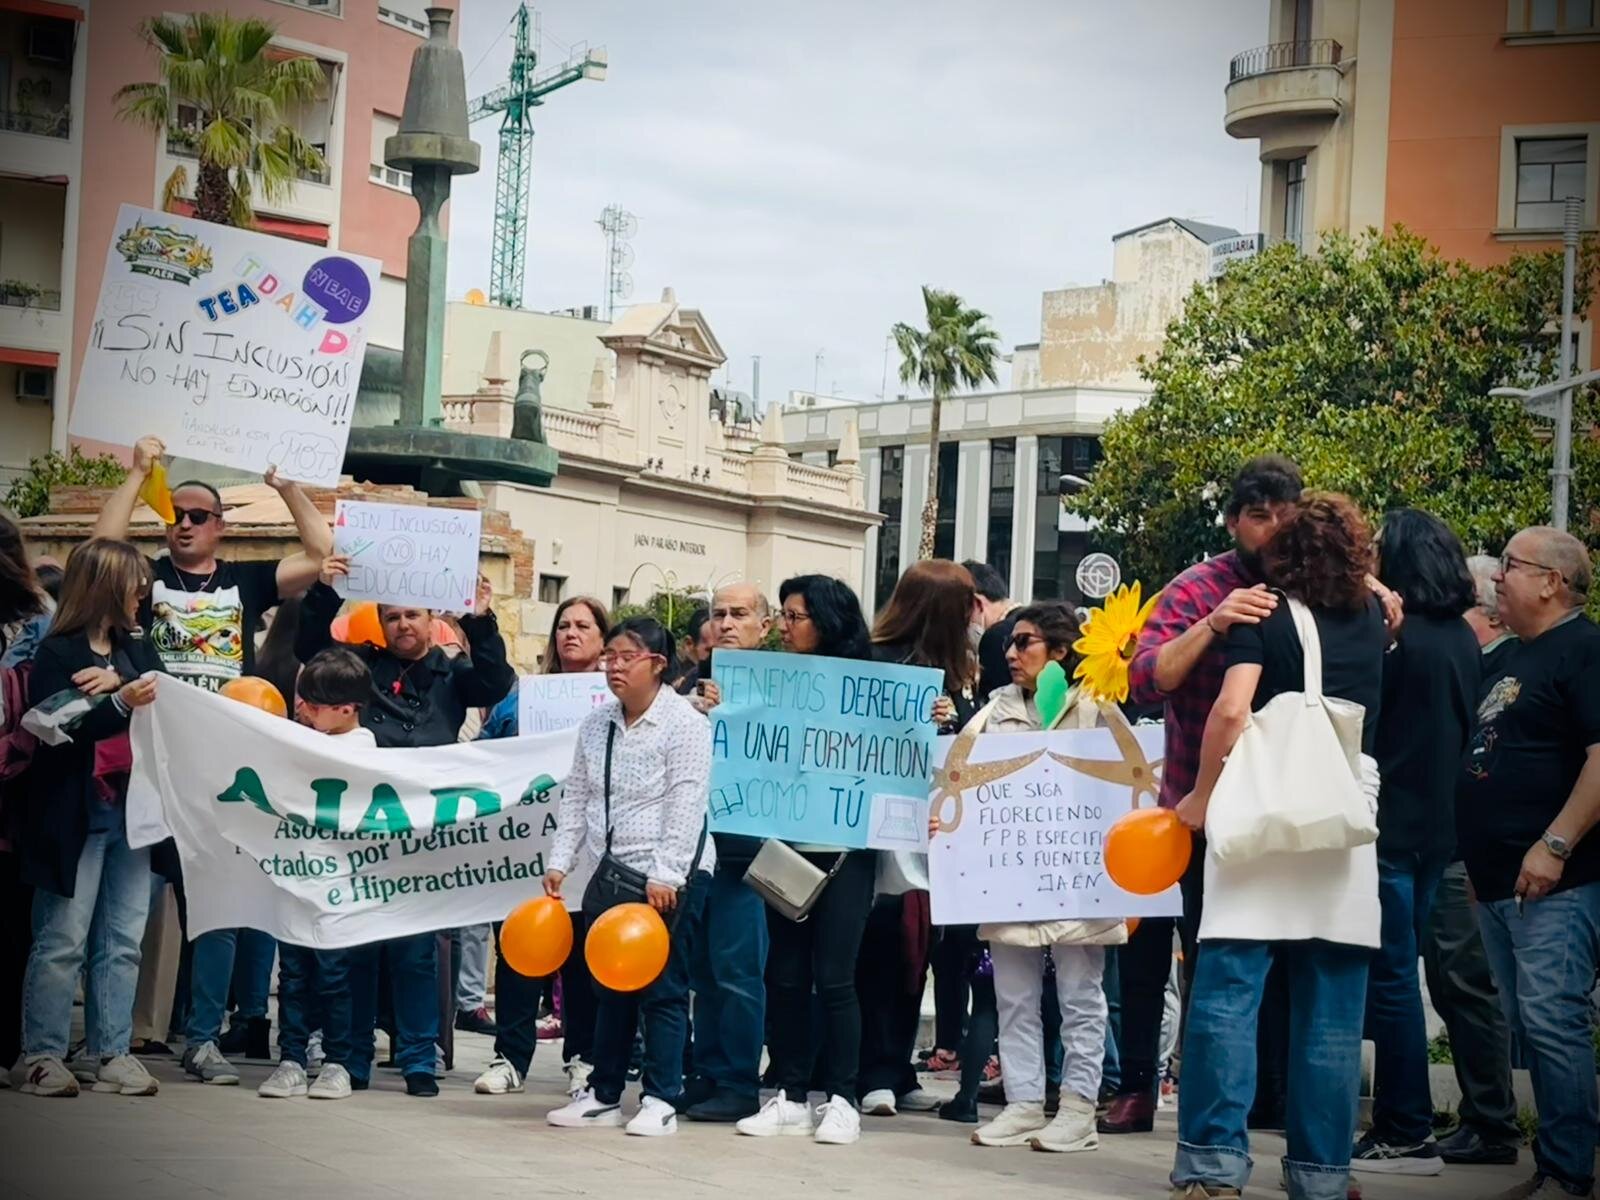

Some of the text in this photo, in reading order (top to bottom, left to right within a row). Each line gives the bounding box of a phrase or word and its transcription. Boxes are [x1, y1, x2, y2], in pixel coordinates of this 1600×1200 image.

[199, 283, 260, 321] TEA
[309, 268, 363, 313] NEAE
[120, 354, 156, 385] NO
[166, 363, 209, 405] HAY
[385, 542, 450, 564] NO HAY
[534, 679, 582, 699] NEAE
[716, 664, 938, 725] TENEMOS DERECHO
[713, 719, 929, 779] A UNA FORMACIÓN
[746, 777, 866, 828] COMO TÚ
[1025, 782, 1062, 798] SIGA
[980, 805, 1102, 825] FLORECIENDO
[347, 842, 390, 873] por
[499, 816, 531, 841] de
[1034, 850, 1101, 867] FUENTEZ
[1037, 830, 1102, 846] ESPECIFI
[327, 852, 546, 906] e Hiperactividad
